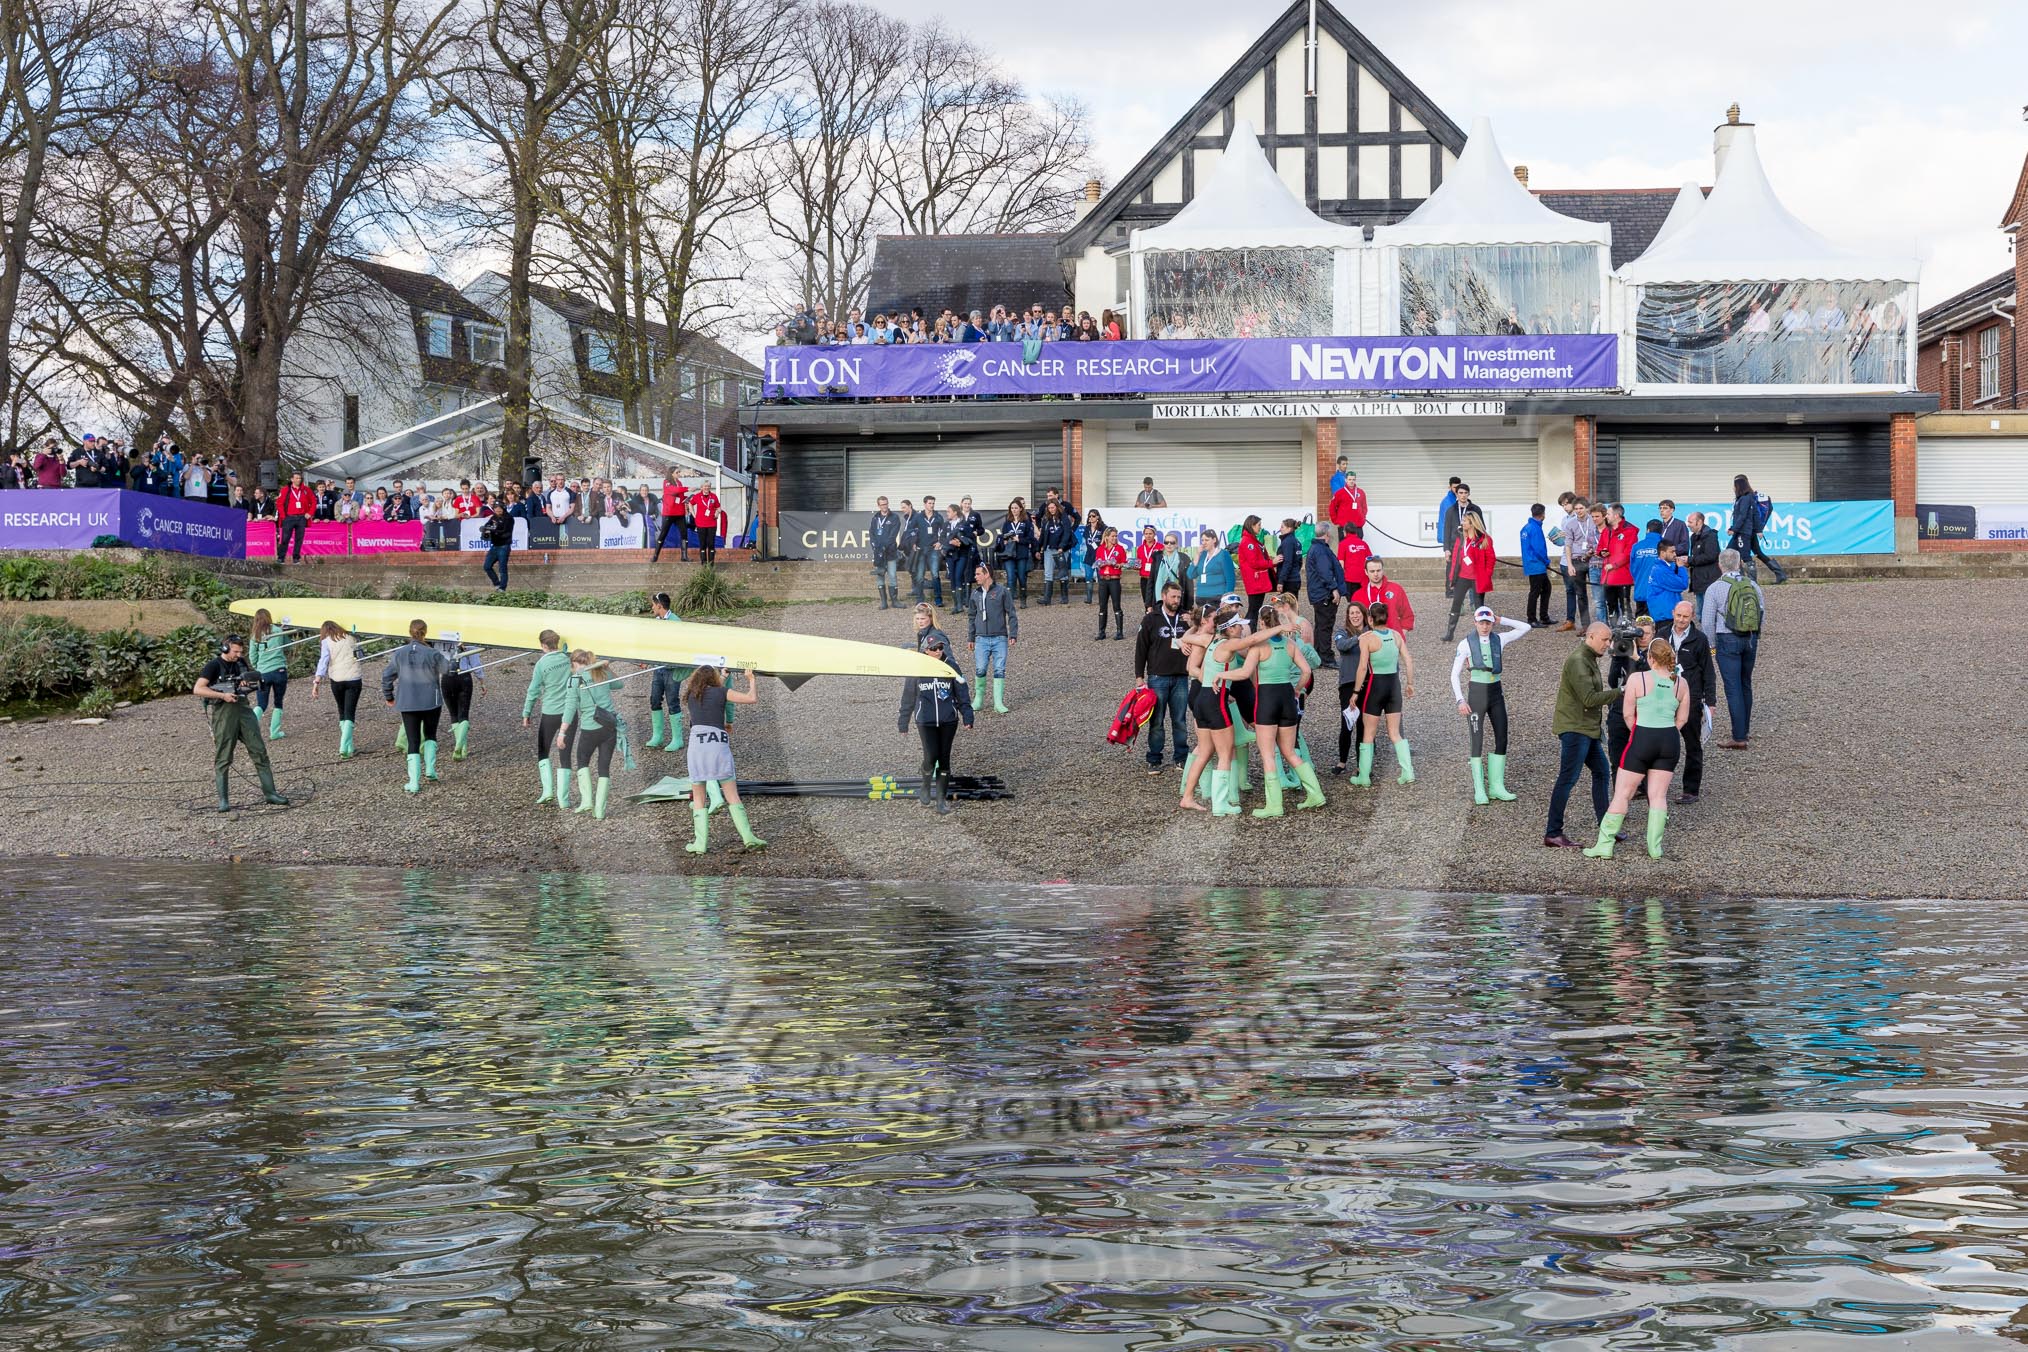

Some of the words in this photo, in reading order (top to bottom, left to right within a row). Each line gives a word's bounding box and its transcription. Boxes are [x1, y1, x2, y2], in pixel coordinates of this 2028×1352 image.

[1291, 343, 1456, 381] NEWTON
[1463, 346, 1556, 362] Investment
[768, 358, 862, 385] LLON
[982, 359, 1065, 377] CANCER
[1076, 357, 1180, 376] RESEARCH
[1190, 357, 1218, 374] UK
[1463, 364, 1574, 382] Management
[1155, 405, 1241, 417] MORTLAKE
[1250, 403, 1320, 416] ANGLIAN
[1330, 403, 1340, 415] &
[1350, 403, 1402, 415] ALPHA
[1414, 402, 1452, 415] BOAT
[1461, 402, 1503, 414] CLUB
[4, 512, 80, 527] RESEARCH
[88, 512, 108, 526] UK
[153, 518, 183, 534] CANCER
[186, 523, 221, 540] RESEARCH
[223, 528, 233, 541] UK
[1943, 525, 1967, 533] DOWN
[357, 538, 393, 547] NEWTON
